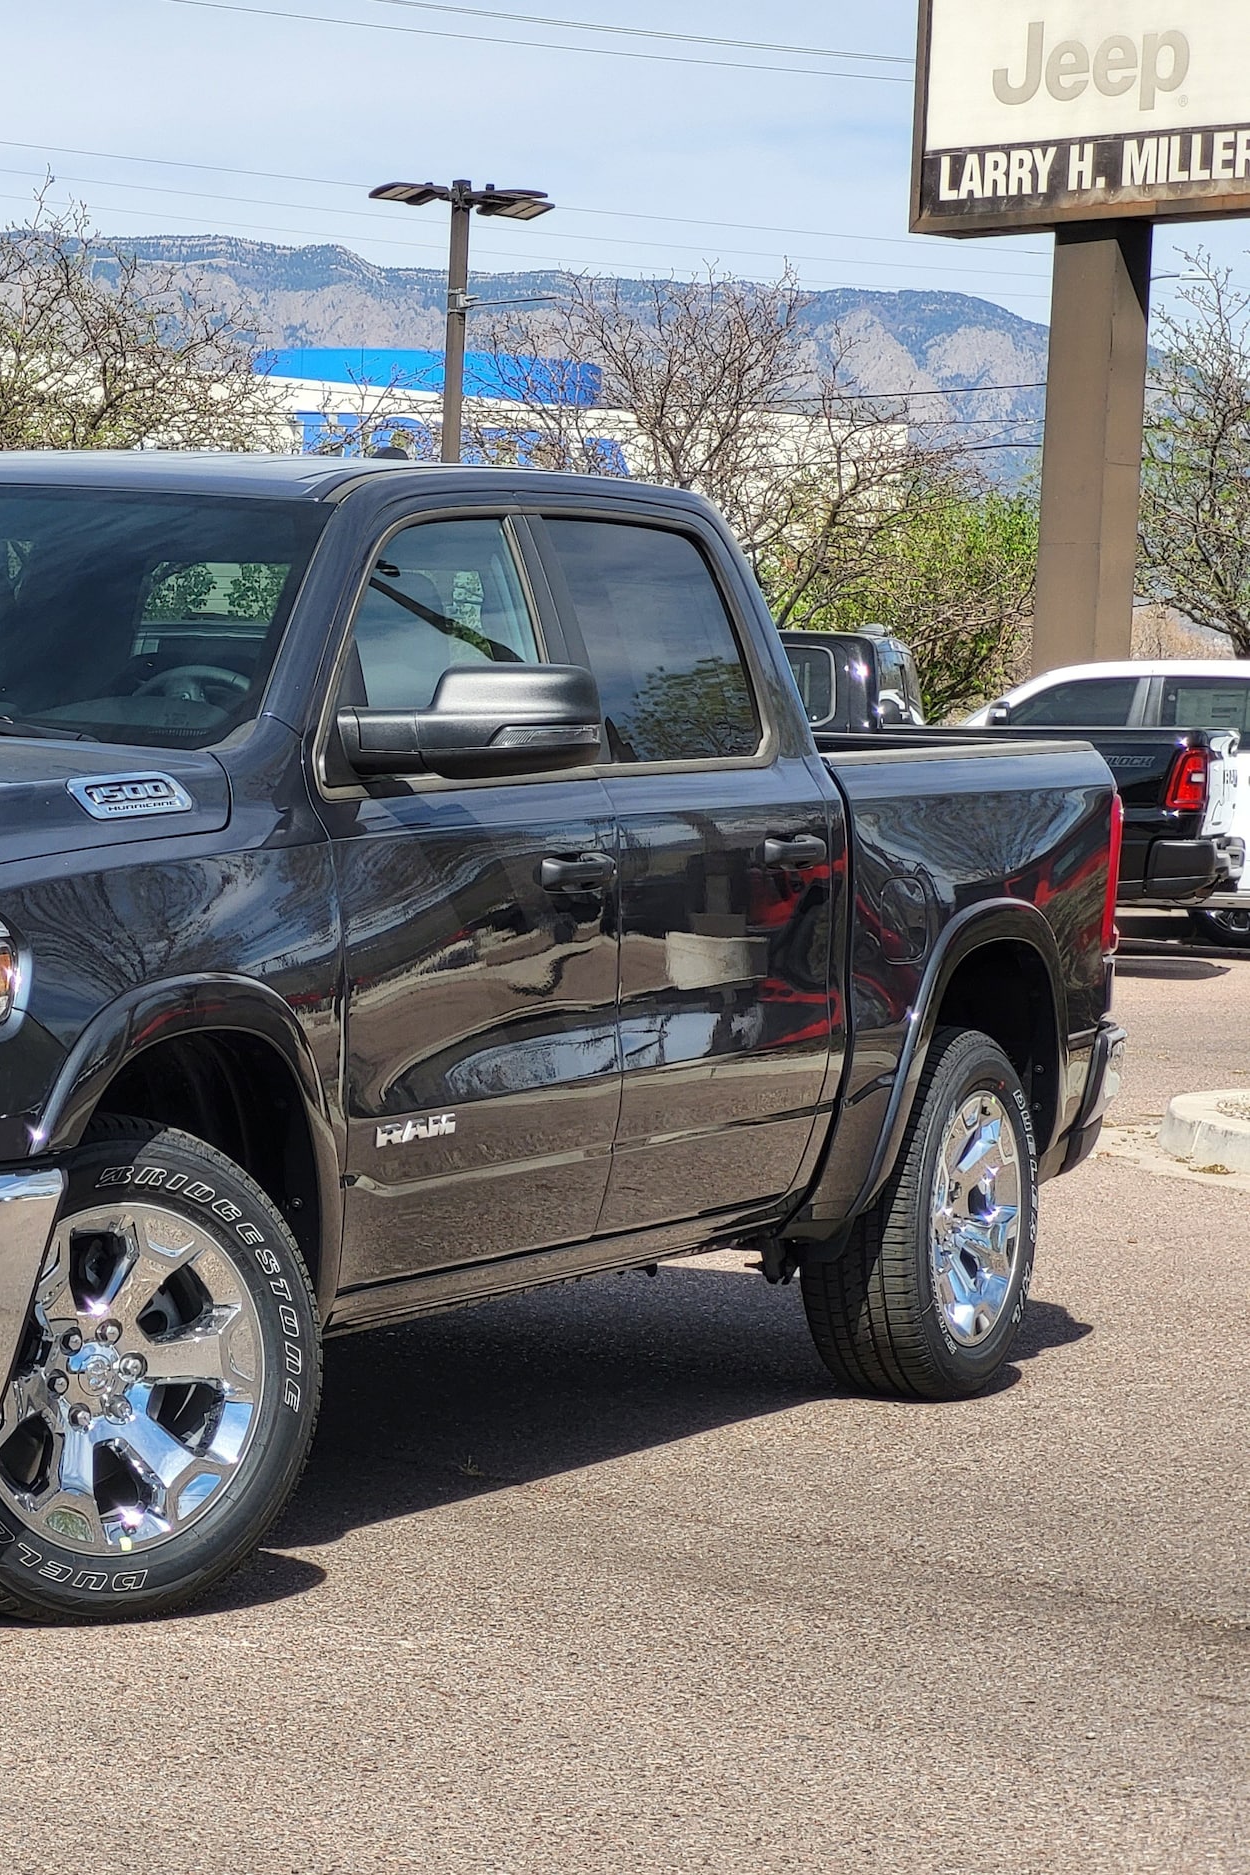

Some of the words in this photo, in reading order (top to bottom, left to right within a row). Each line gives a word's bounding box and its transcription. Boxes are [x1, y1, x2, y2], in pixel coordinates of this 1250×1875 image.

[992, 21, 1190, 111] Jeep
[939, 146, 1057, 201] LARRY
[1067, 143, 1105, 191] H.
[1121, 131, 1250, 186] MILLER
[1104, 755, 1155, 768] LOCK
[86, 782, 170, 804] 1500
[108, 800, 178, 812] HURRICANE
[376, 1113, 456, 1148] RAM
[95, 1165, 300, 1414] BRIDGESTONE
